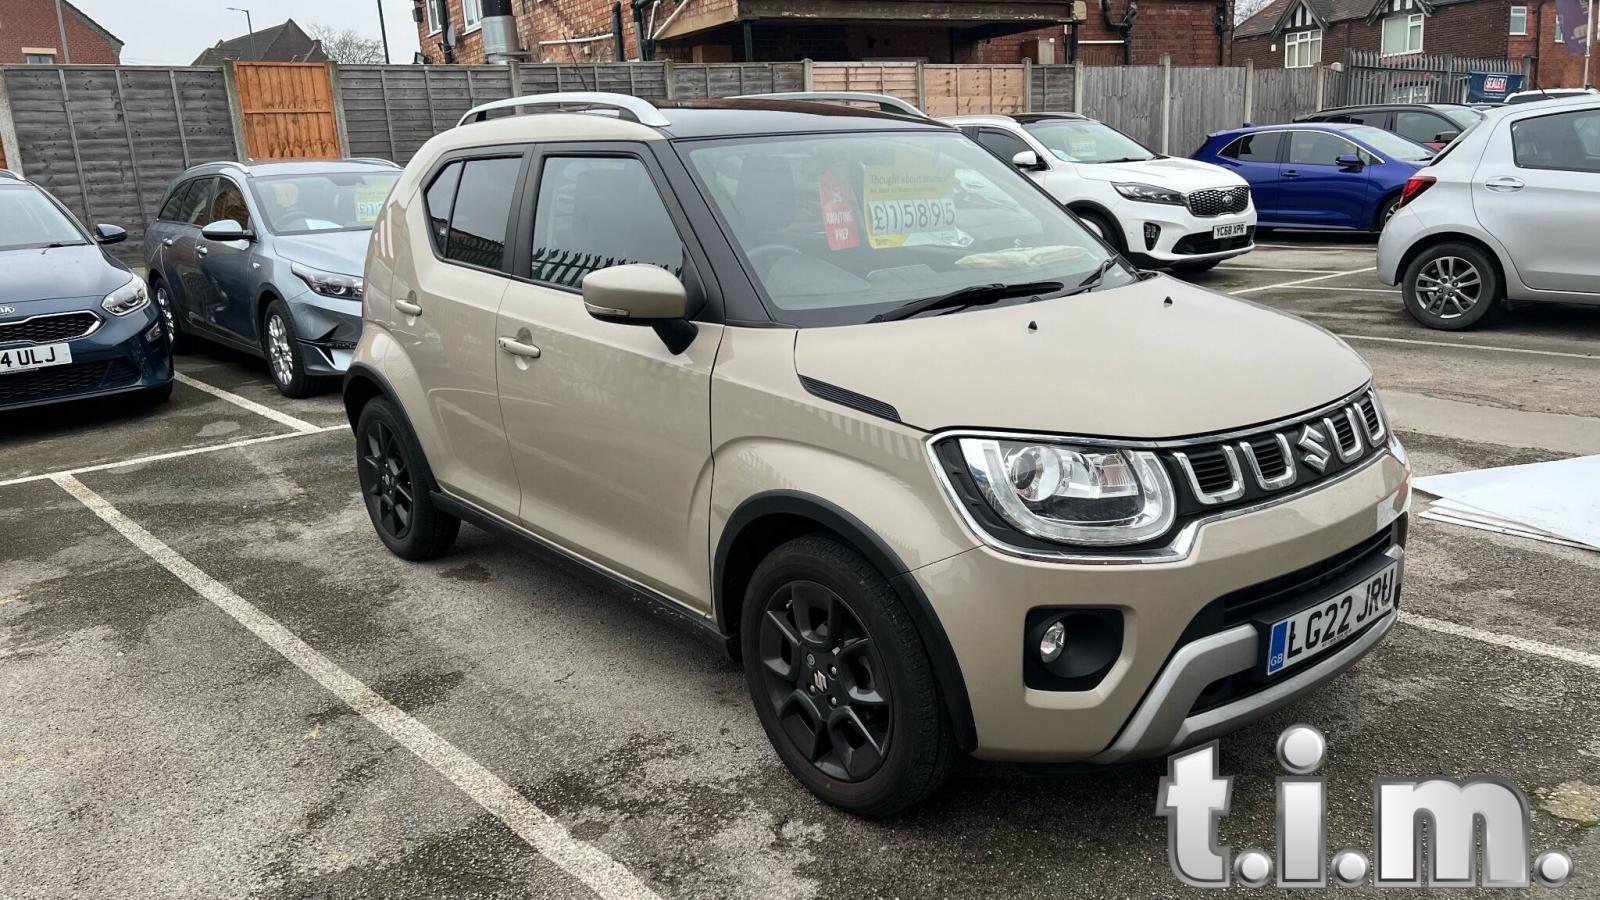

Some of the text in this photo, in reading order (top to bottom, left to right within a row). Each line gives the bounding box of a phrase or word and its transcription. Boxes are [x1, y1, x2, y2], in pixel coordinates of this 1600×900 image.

[874, 202, 955, 231] £15895
[1233, 224, 1245, 235] XPR
[17, 346, 56, 366] ULJ
[1287, 568, 1394, 660] LG22 JRU
[1270, 653, 1283, 667] GB
